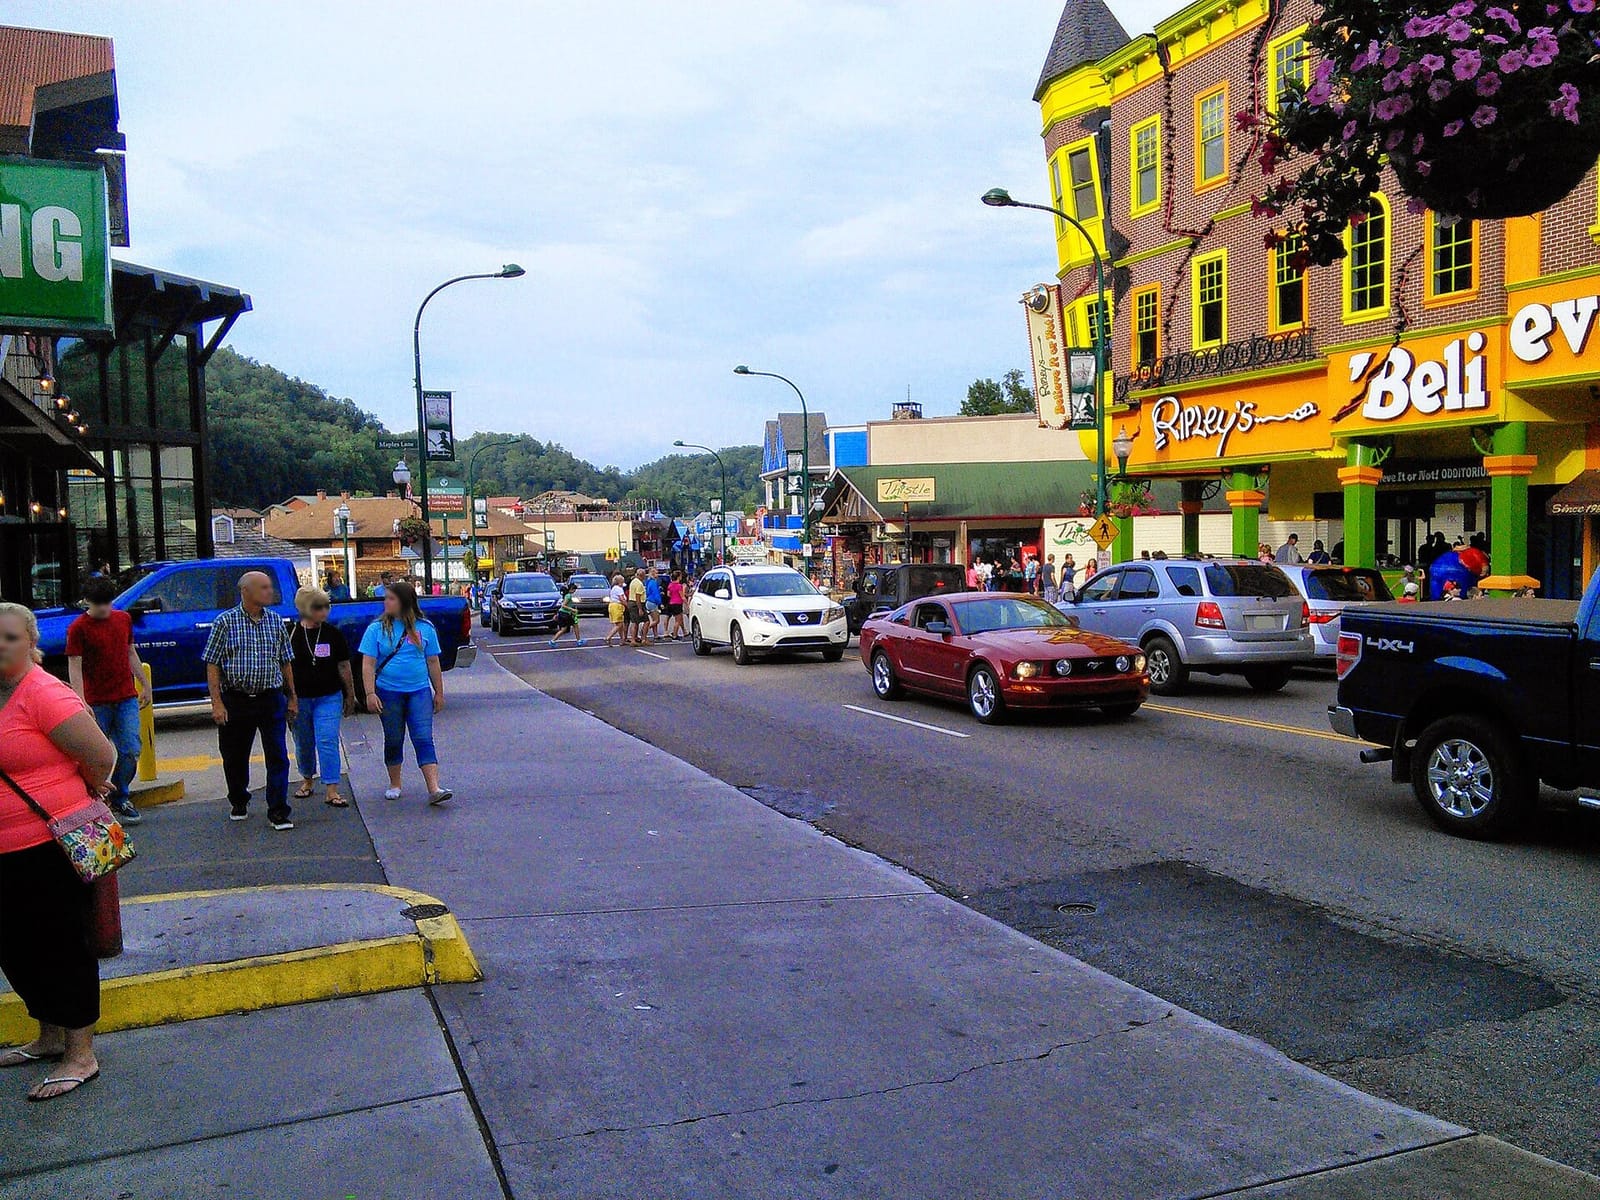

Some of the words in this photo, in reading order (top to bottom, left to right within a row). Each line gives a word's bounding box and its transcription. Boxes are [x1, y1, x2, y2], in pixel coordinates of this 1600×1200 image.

[1043, 314, 1057, 340] Not!
[1049, 341, 1059, 355] or
[1053, 370, 1065, 415] Believe
[1398, 471, 1406, 481] It
[1406, 473, 1417, 482] or
[1418, 469, 1439, 481] Not!
[881, 479, 931, 497] Thistle
[1551, 503, 1585, 514] Since
